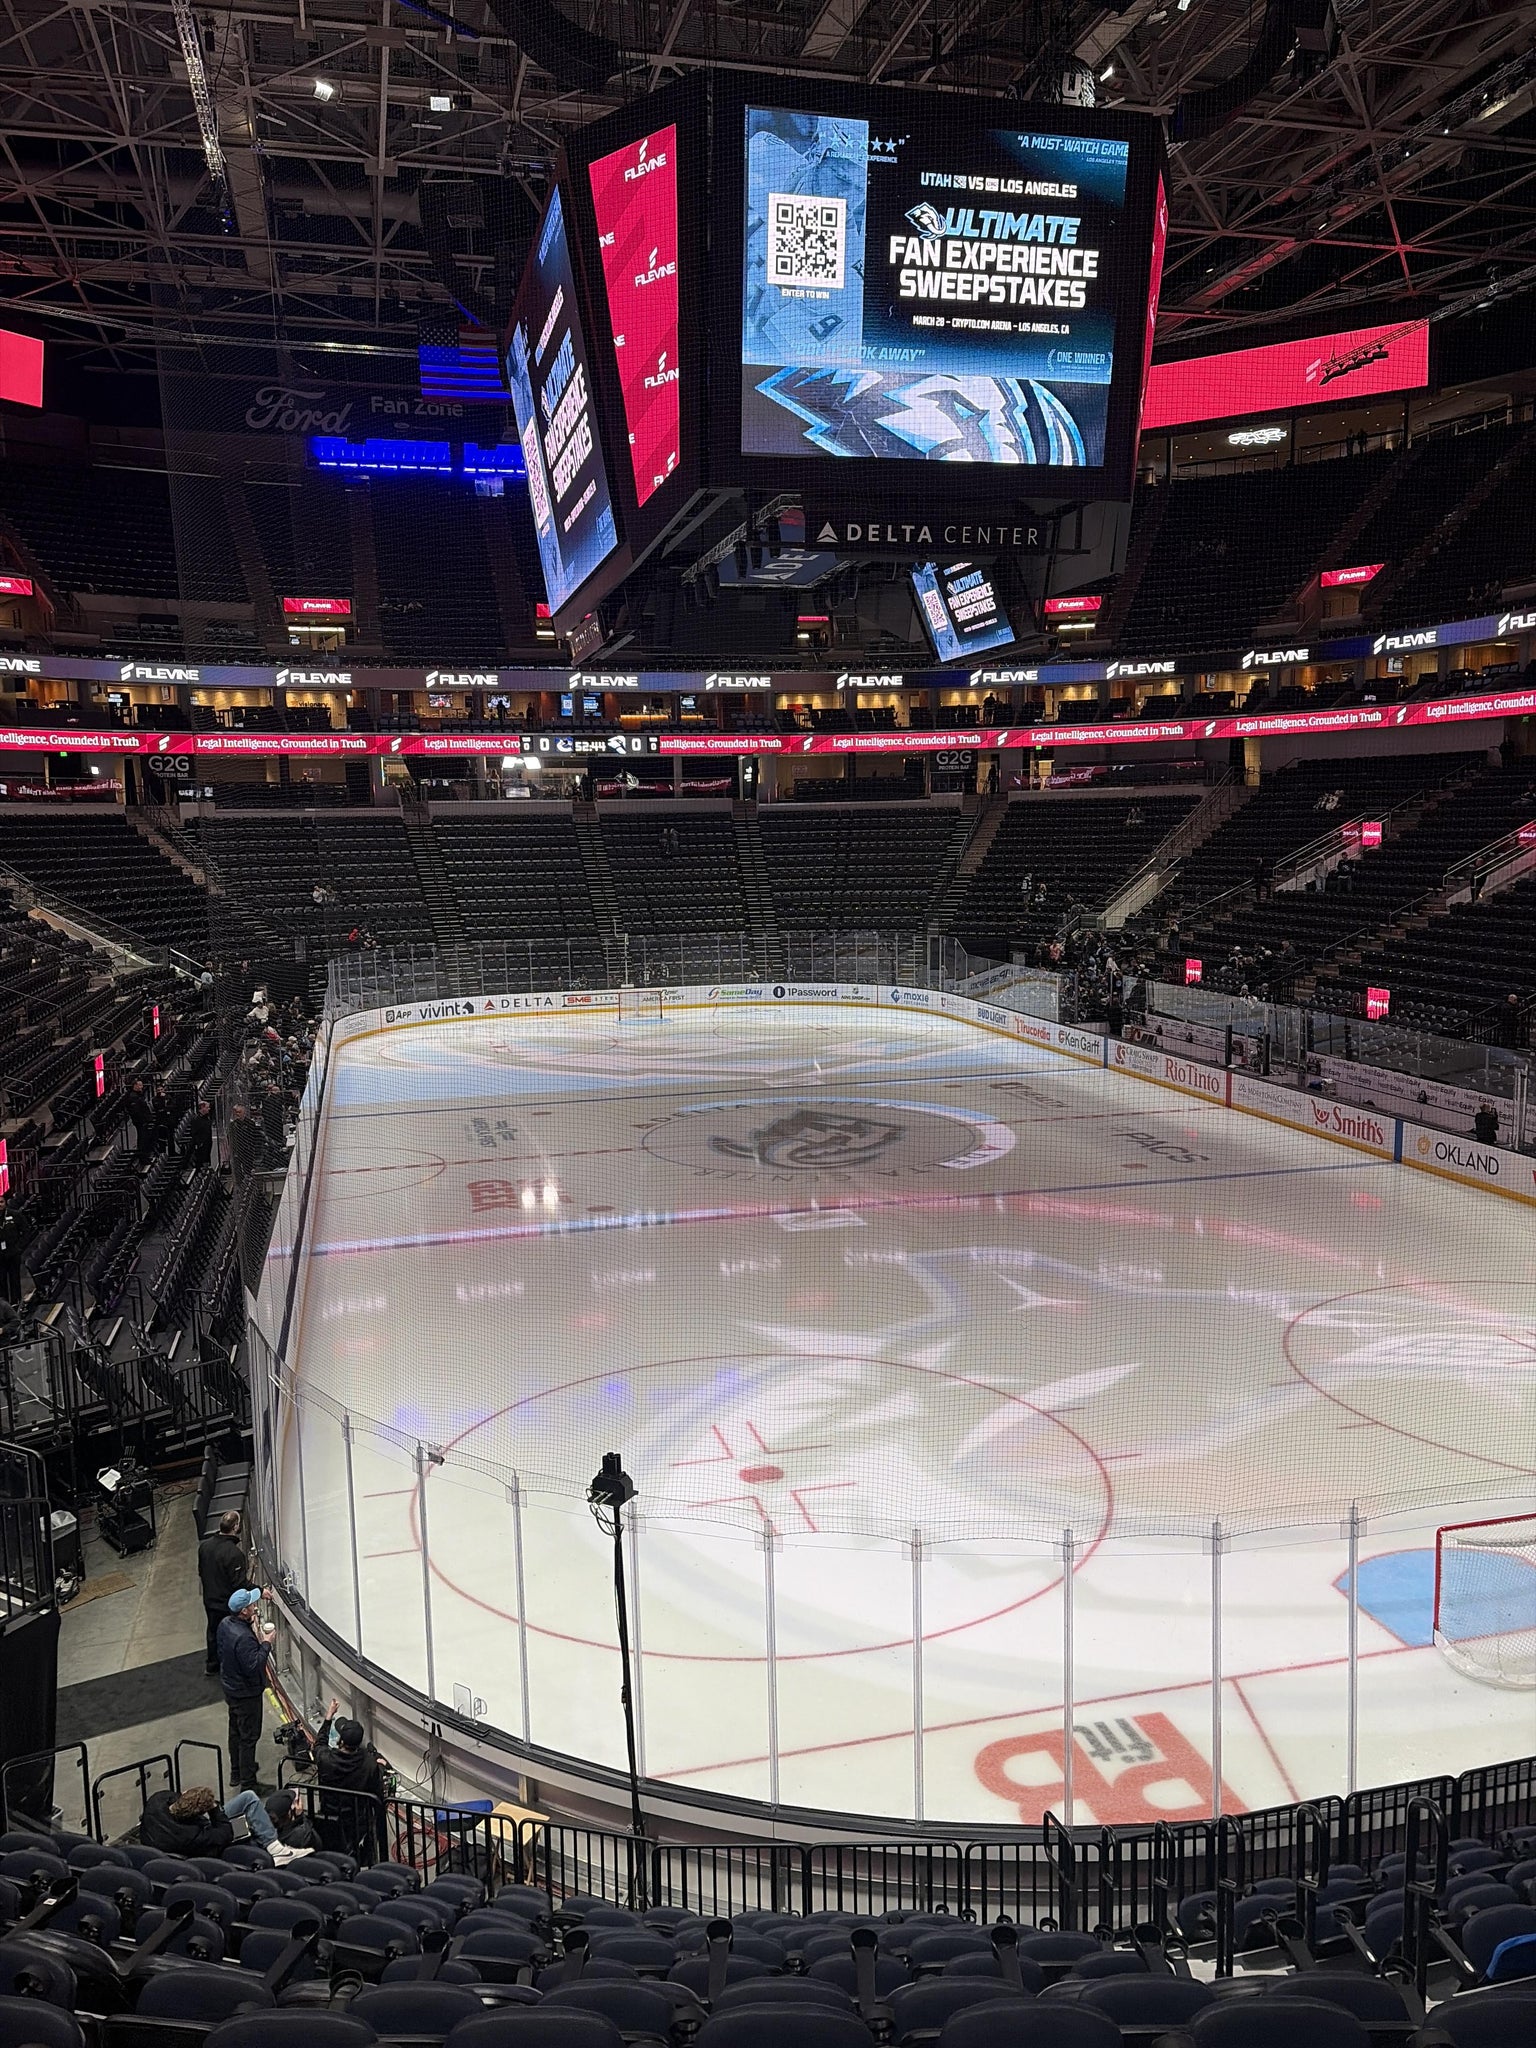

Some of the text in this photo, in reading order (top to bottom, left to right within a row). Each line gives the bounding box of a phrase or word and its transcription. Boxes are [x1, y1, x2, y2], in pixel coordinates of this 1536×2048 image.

[1031, 138, 1100, 155] MUST-WATCH
[624, 153, 667, 183] FILEVINE
[921, 172, 1078, 198] UTAH VS LOS ANGELES
[946, 207, 1081, 244] ULTIMATE
[889, 236, 1099, 278] FAN EXPERIENCE
[634, 261, 676, 288] FILEVINE
[782, 288, 830, 300] ENTER TO WIN
[899, 268, 1087, 308] SWEEPSTAKES
[912, 315, 935, 327] MARCH
[935, 317, 945, 327] 28
[951, 318, 990, 330] CRYPTO.COM
[991, 320, 1012, 331] ARENA
[1018, 323, 1030, 333] LOS
[1060, 325, 1070, 335] CA
[1057, 351, 1106, 365] ONE WINNER
[245, 386, 354, 433] Ford
[370, 396, 464, 417] Fan Zone
[847, 523, 1039, 546] DELTA CENTER
[952, 570, 984, 594] ULTIMATE
[959, 581, 995, 608] EXPERIENCE
[955, 597, 997, 623] SWEEPSTAKES
[1386, 631, 1437, 649] FILEVINE
[1254, 649, 1309, 664] FILEVINE
[135, 667, 200, 681] FILEVINE
[1119, 661, 1175, 675] FILEVINE
[290, 672, 352, 684] FILEVINE
[439, 674, 499, 686] FILEVINE
[582, 675, 638, 687] FILEVINE
[717, 676, 771, 687] FILEVINE
[849, 675, 903, 687] FILEVINE
[982, 670, 1038, 683] FILEVINE
[1427, 696, 1533, 717] Legal Intelligence, Grounded
[1236, 711, 1382, 732] Legal Intelligence, Grounded in Truth
[1031, 725, 1183, 742] Legal Intelligence, Grounded in Truth
[50, 735, 99, 747] Grounded
[100, 736, 110, 747] in
[111, 737, 139, 747] Truth
[197, 738, 367, 750] Legal Intelligence, Grounded in Truth
[424, 739, 448, 750] Legal
[449, 740, 503, 750] Intelligence,
[540, 738, 550, 751] 0
[575, 742, 606, 752] 52:44
[631, 738, 641, 751] 0
[650, 743, 657, 751] 0
[707, 739, 749, 748] Grounded
[749, 738, 758, 747] in
[759, 738, 782, 748] Truth
[832, 734, 981, 749] Legal Intelligence, Grounded in Truth
[149, 755, 189, 771] G2G
[936, 751, 972, 765] G2G
[720, 988, 763, 996] SameDay
[787, 988, 837, 997] 1Password
[903, 993, 929, 1003] moxie
[501, 996, 553, 1009] DELTA
[567, 995, 592, 1004] SME
[420, 1002, 460, 1019] vivint
[978, 1008, 1007, 1025] BUD LIGHT
[1435, 1142, 1500, 1176] OKLAND
